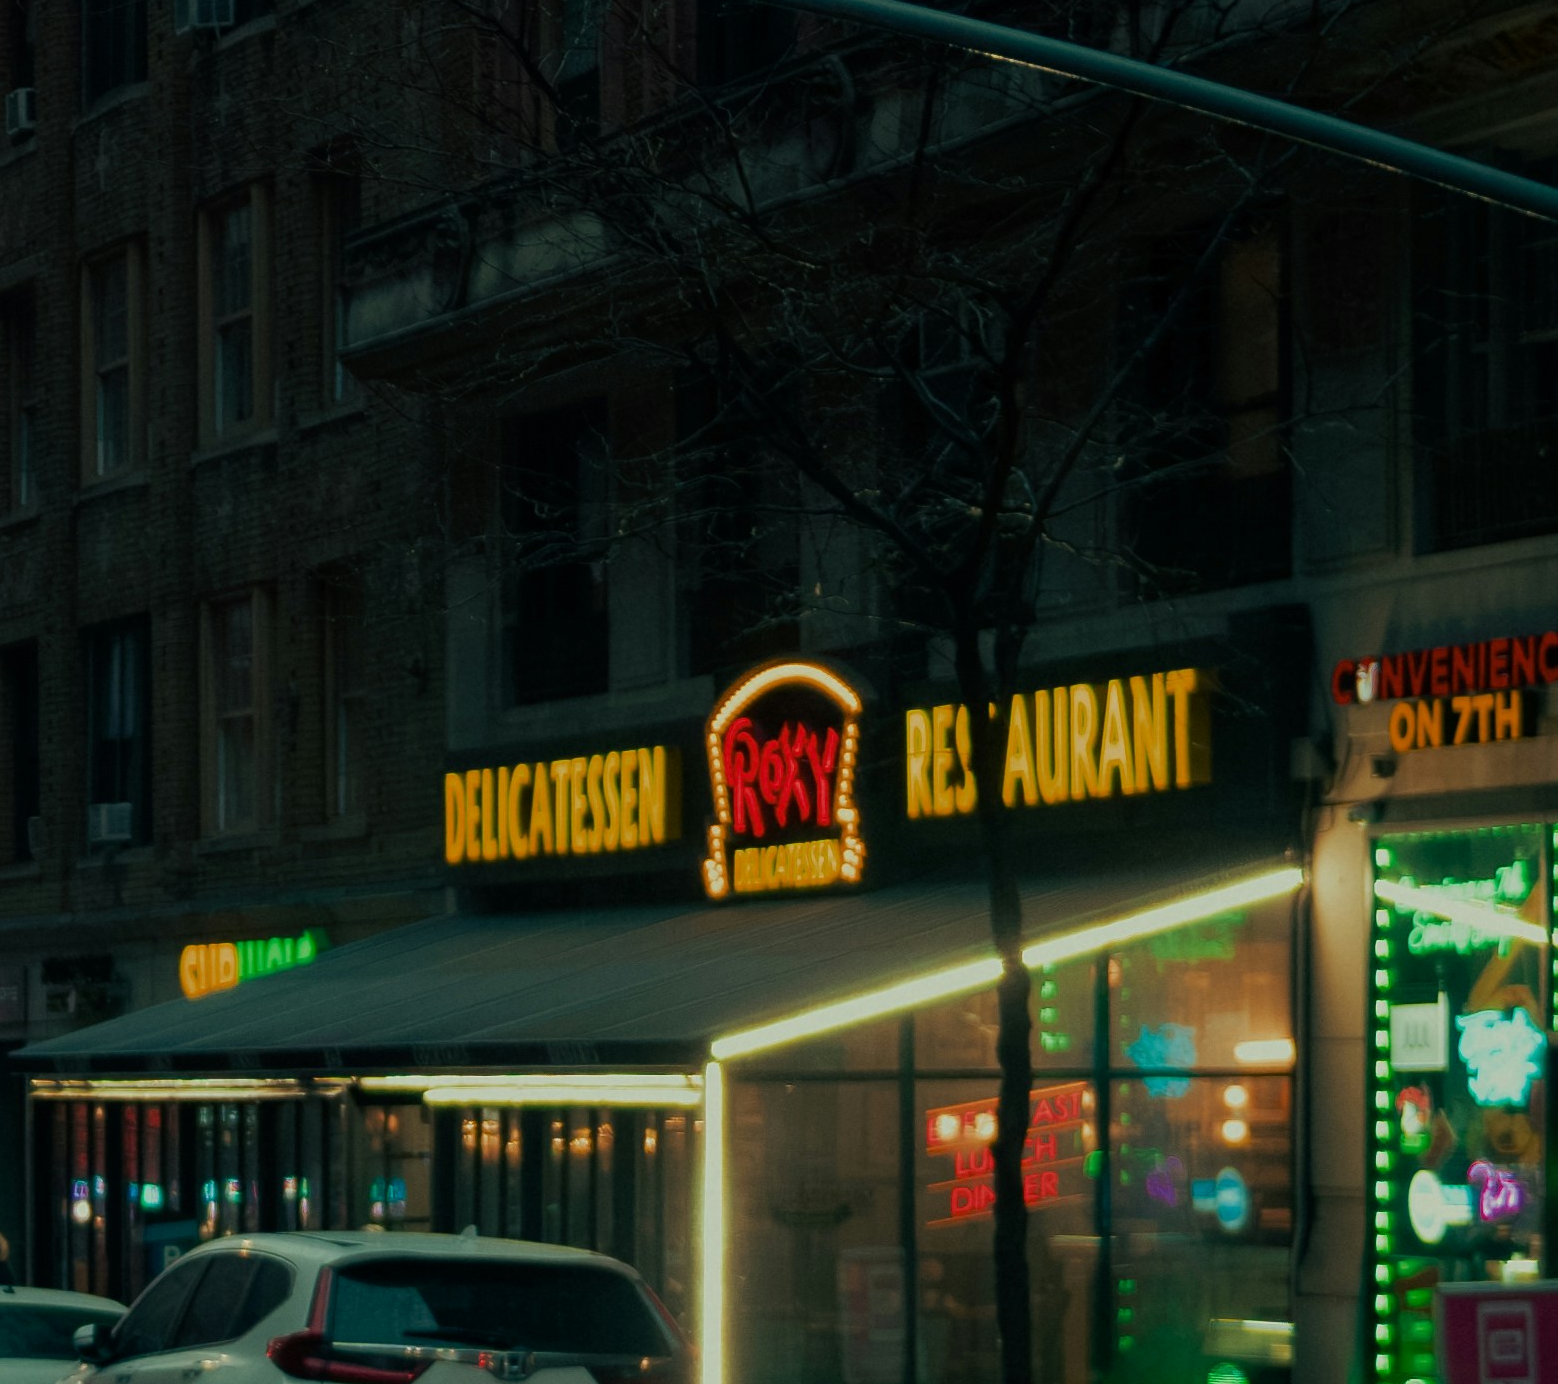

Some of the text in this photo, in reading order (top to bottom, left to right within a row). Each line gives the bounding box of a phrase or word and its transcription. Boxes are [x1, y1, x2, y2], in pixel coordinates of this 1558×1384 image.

[1331, 630, 1558, 706] CNVENIENC
[905, 668, 1197, 820] RESAURANT
[1389, 688, 1524, 753] ON 7TH
[444, 745, 666, 865] DELICATESSEN
[954, 1131, 1058, 1180] LUCH
